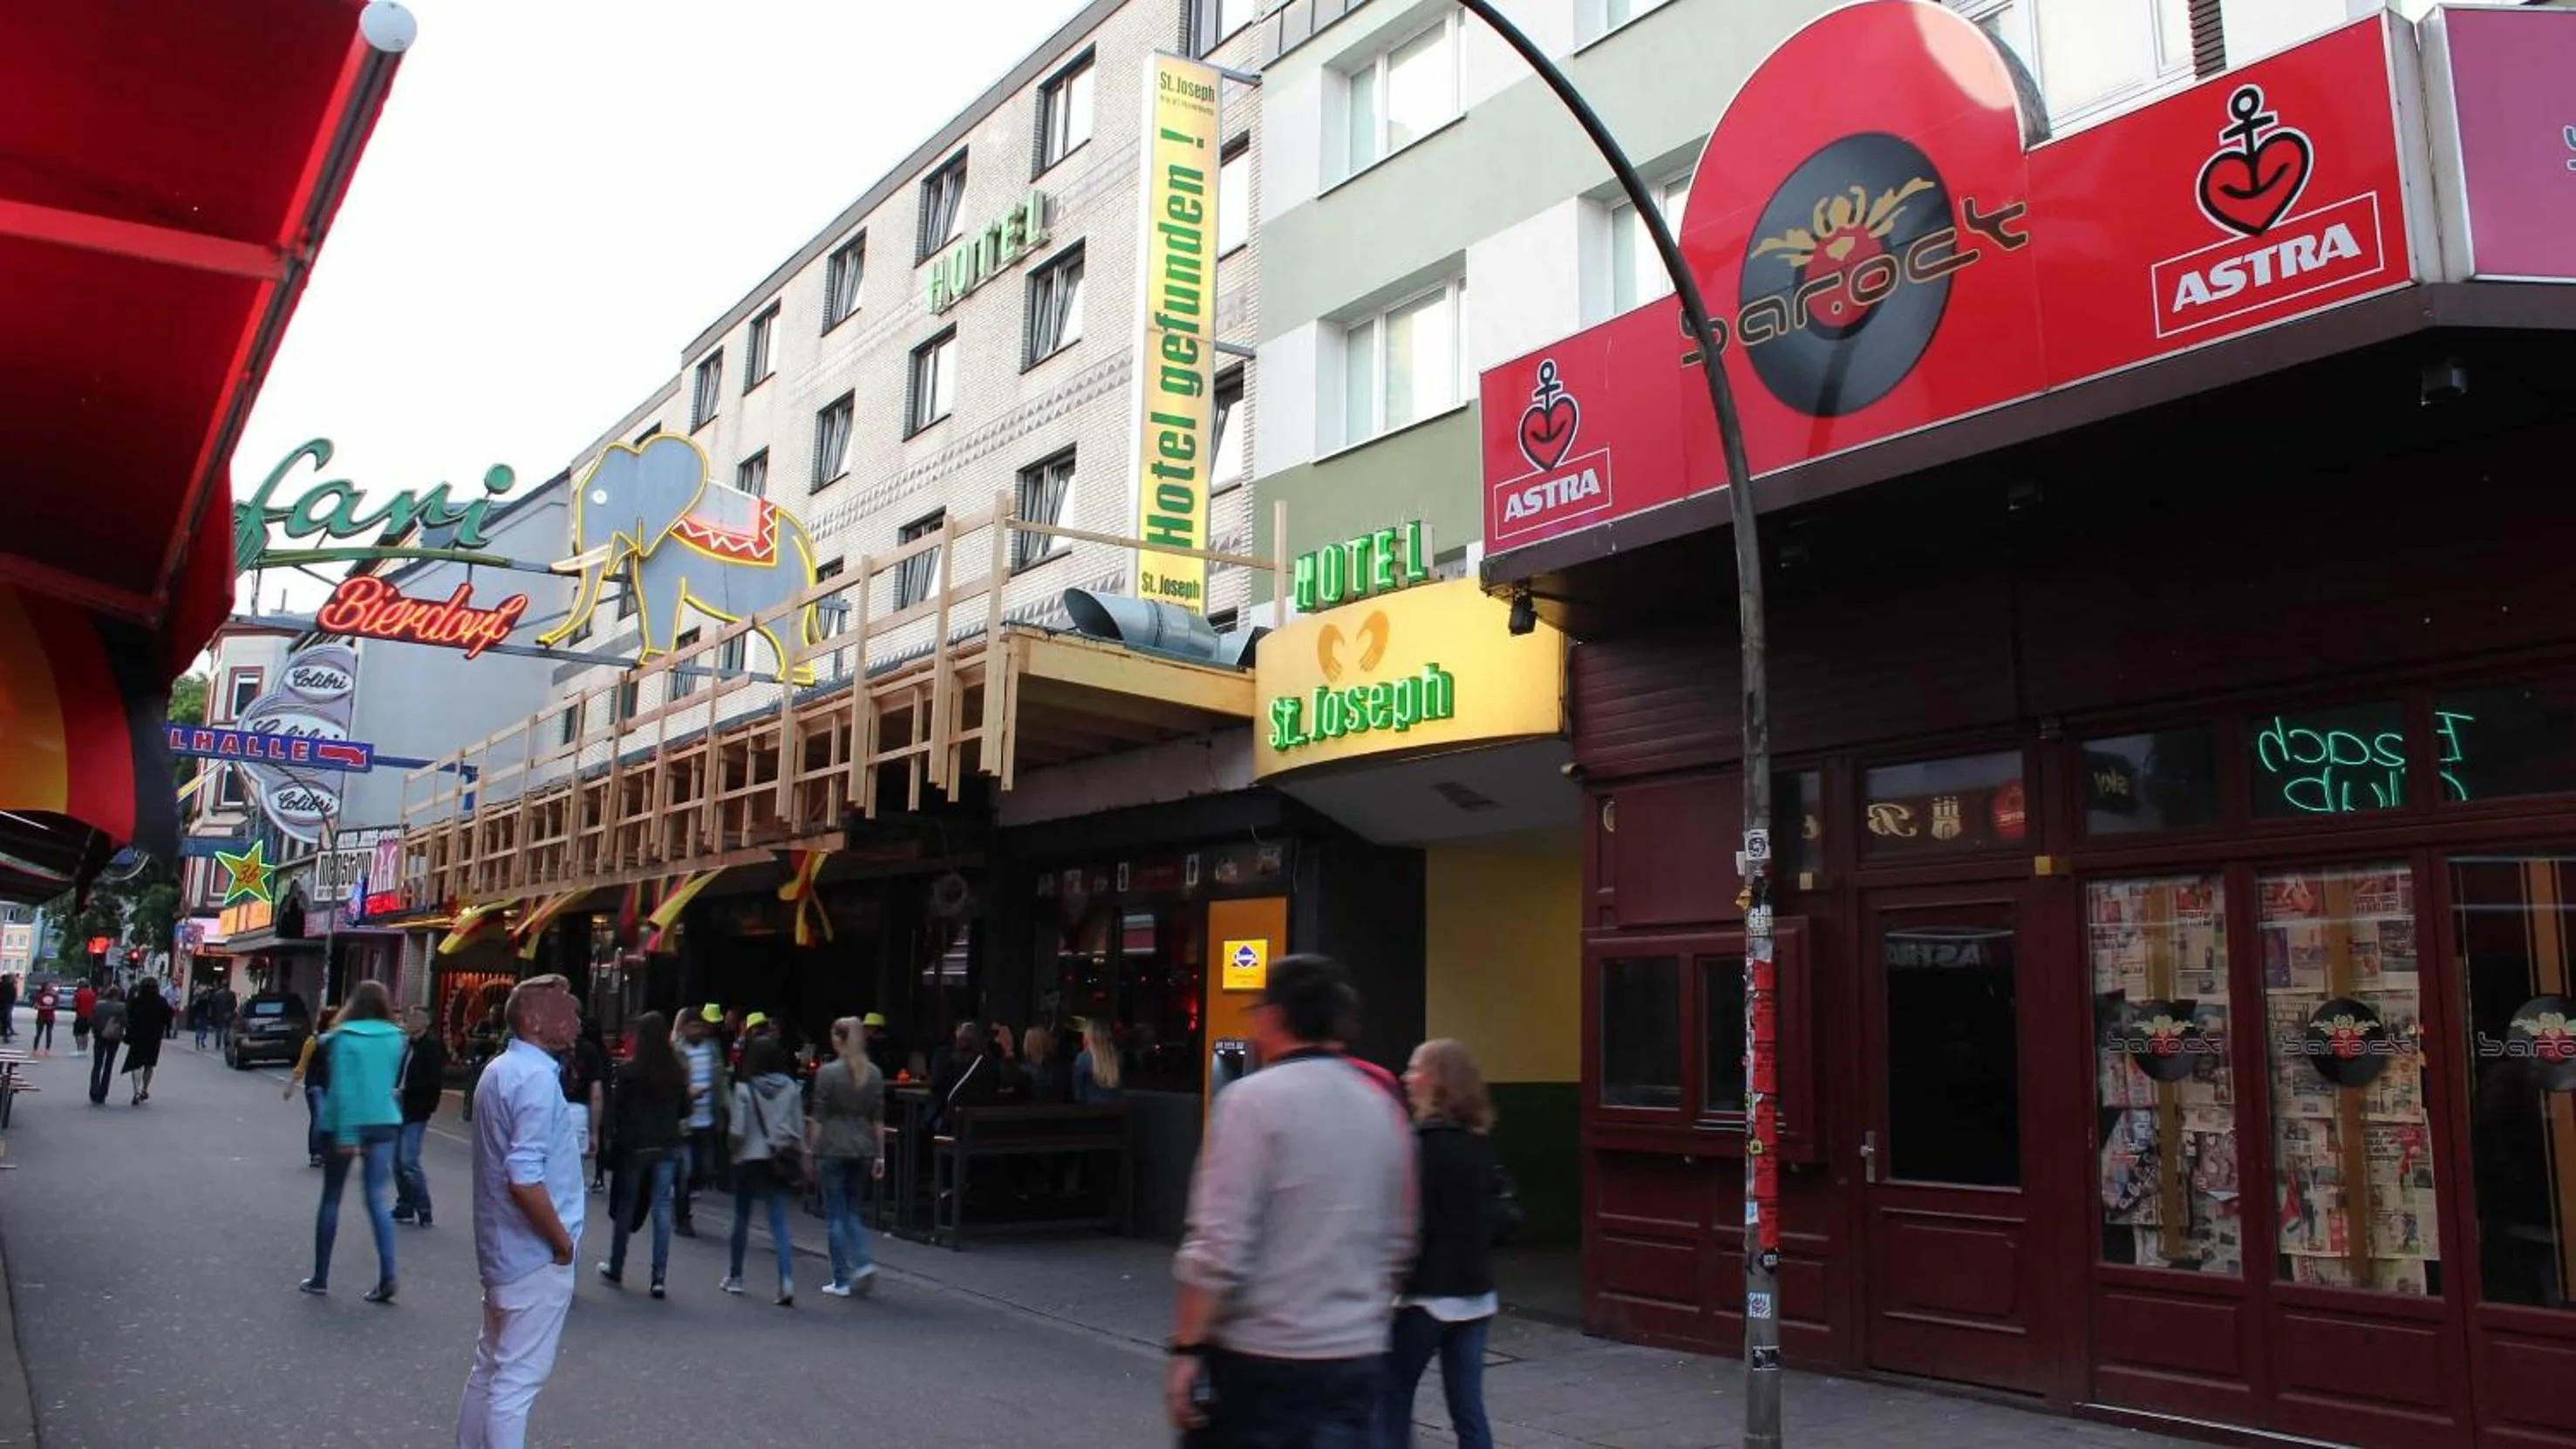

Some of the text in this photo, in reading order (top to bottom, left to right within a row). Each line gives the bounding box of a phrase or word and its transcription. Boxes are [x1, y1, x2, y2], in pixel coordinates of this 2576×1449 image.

[1176, 76, 1216, 103] Joseph
[925, 189, 1046, 315] HOTEL
[1154, 163, 1204, 399] gefunden
[2171, 222, 2362, 314] ASTRA
[1146, 411, 1197, 549] Hotel
[1503, 467, 1602, 523] ASTRA
[1158, 574, 1201, 601] Joseph
[1293, 519, 1432, 613] HOTEL
[319, 576, 528, 660] Bierdorf
[293, 667, 348, 690] Colibri
[1309, 663, 1455, 743] Joseph
[168, 727, 311, 762] LHALLE
[277, 791, 333, 813] Colibri
